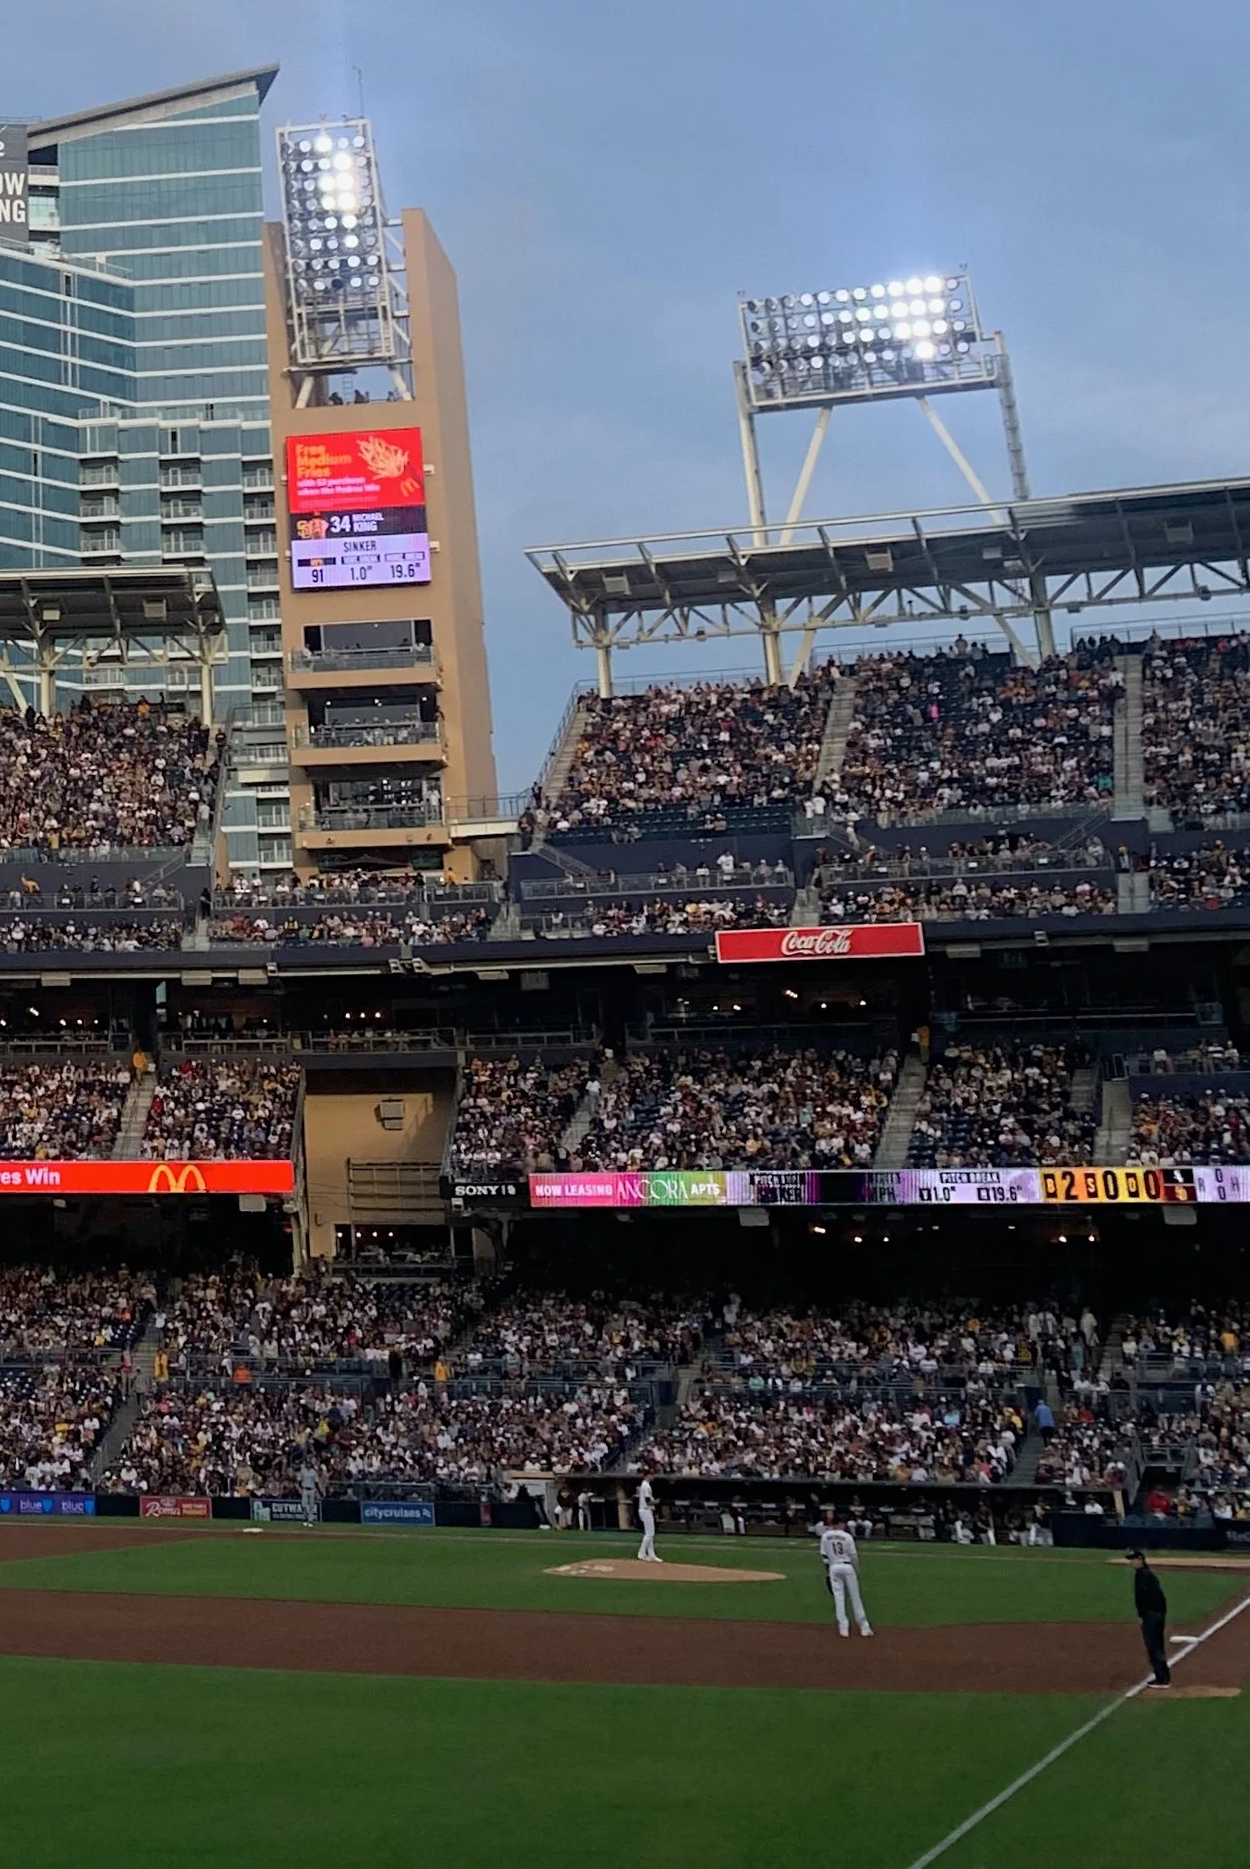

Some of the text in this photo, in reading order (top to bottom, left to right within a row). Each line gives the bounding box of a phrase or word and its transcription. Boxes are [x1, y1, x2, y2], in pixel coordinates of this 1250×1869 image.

[330, 516, 350, 533] 34
[353, 521, 377, 532] KING
[343, 540, 377, 552] SINKER
[312, 569, 324, 583] 91
[781, 930, 853, 956] Coca-Cola
[26, 1168, 61, 1185] Win
[1215, 1168, 1223, 1182] 0
[455, 1185, 499, 1196] SONY
[535, 1178, 722, 1200] NOW LEASING ANCORA APTS
[1061, 1171, 1078, 1200] 2
[1103, 1170, 1119, 1200] 0
[1144, 1170, 1160, 1199] 0
[1218, 1186, 1226, 1200] 0
[20, 1499, 42, 1510] blue
[62, 1500, 84, 1511] blue
[146, 1501, 180, 1517] Roma
[364, 1506, 421, 1519] citycruises
[832, 1540, 844, 1556] 13
